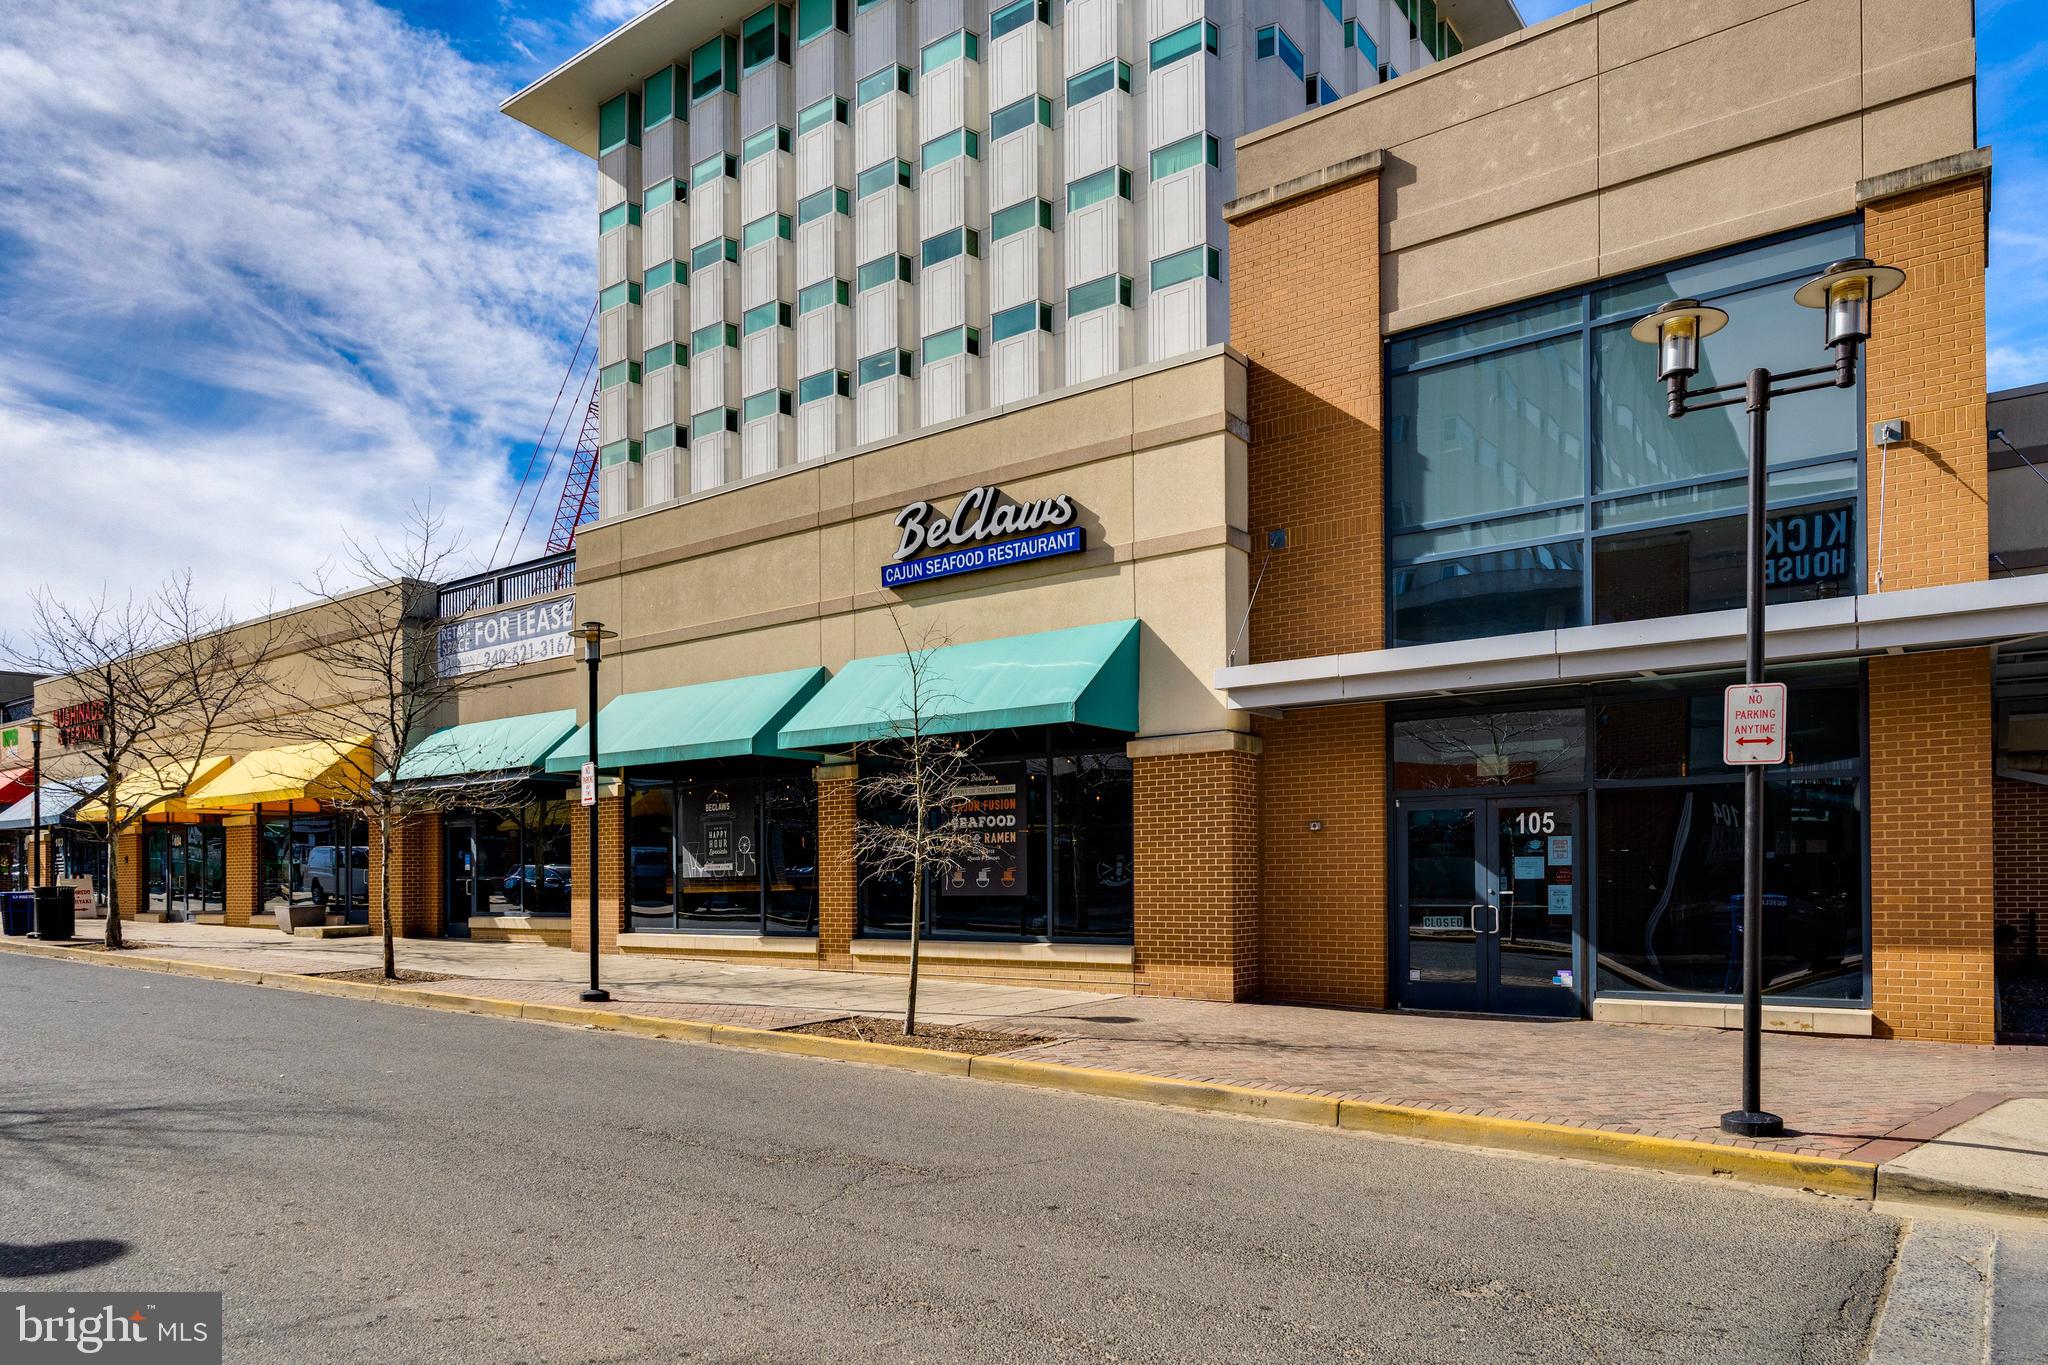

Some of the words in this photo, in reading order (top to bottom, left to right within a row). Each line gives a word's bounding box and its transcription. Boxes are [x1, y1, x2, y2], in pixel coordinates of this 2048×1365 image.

[892, 486, 1074, 560] BeClaws
[885, 563, 923, 582] CAJUN
[926, 551, 984, 574] SEAFOOD
[988, 532, 1075, 562] RESTAURANT
[475, 616, 510, 646] FOR
[517, 600, 573, 637] LEASE
[441, 622, 471, 641] RETAIL
[442, 638, 470, 655] SPACE
[484, 637, 573, 667] 240-621-3167
[1749, 695, 1763, 704] NO
[1735, 709, 1776, 720] PARKING
[1734, 724, 1776, 735] ANYTIME
[705, 803, 731, 812] BECLAWS
[984, 799, 1016, 811] FUSION
[952, 815, 1016, 829] SEAFOOD
[1516, 812, 1555, 834] 105
[708, 830, 727, 839] HAPPY
[984, 832, 1016, 844] RAMEN
[708, 839, 728, 848] HOUR
[1424, 917, 1463, 928] CLOSED
